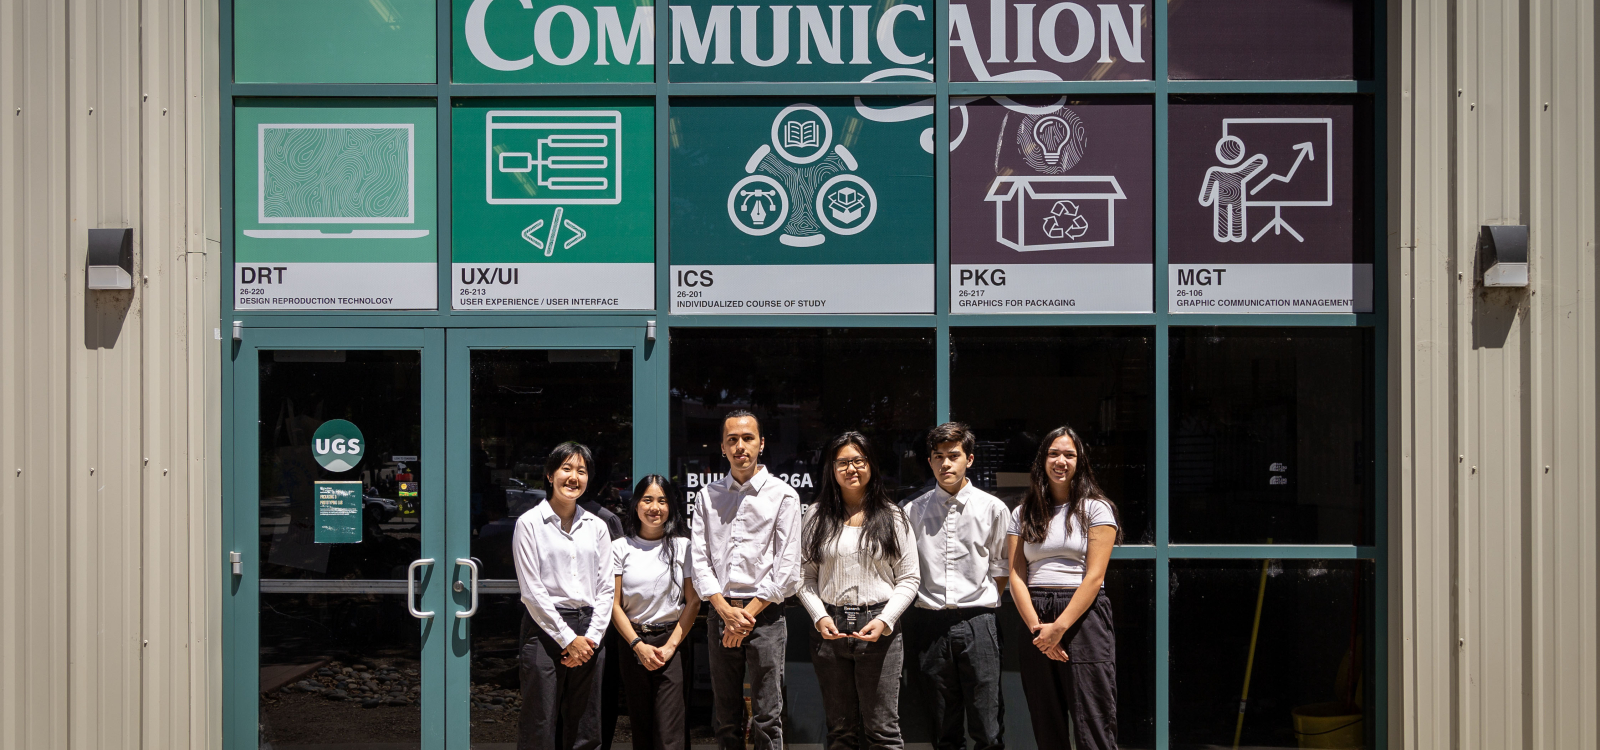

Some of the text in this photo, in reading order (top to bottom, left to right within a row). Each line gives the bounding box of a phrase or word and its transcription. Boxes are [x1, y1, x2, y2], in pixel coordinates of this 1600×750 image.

[241, 266, 288, 285] DRT
[461, 267, 519, 286] UX/UI
[677, 269, 714, 288] ICS
[959, 268, 1006, 287] PKG
[1177, 268, 1227, 287] MGT
[459, 288, 486, 296] 26-213
[676, 290, 702, 298] 26-201
[958, 289, 985, 297] 26-217
[1176, 289, 1203, 297] 26-106
[239, 297, 394, 305] DESIGN REPRODUCTION TECHNOLOGY
[460, 298, 484, 306] USER
[485, 298, 540, 306] EXPERIENCE
[546, 298, 569, 306] USER
[571, 298, 619, 306] INTERFACE
[676, 299, 827, 308] INDIVIDUALIZED COURSE OF STUDY
[958, 298, 1076, 307] GRAPHICS FOR PACKAGING
[1176, 298, 1355, 307] GRAPHIC COMMUNICATION MANAGEMENT
[315, 438, 361, 455] UGS
